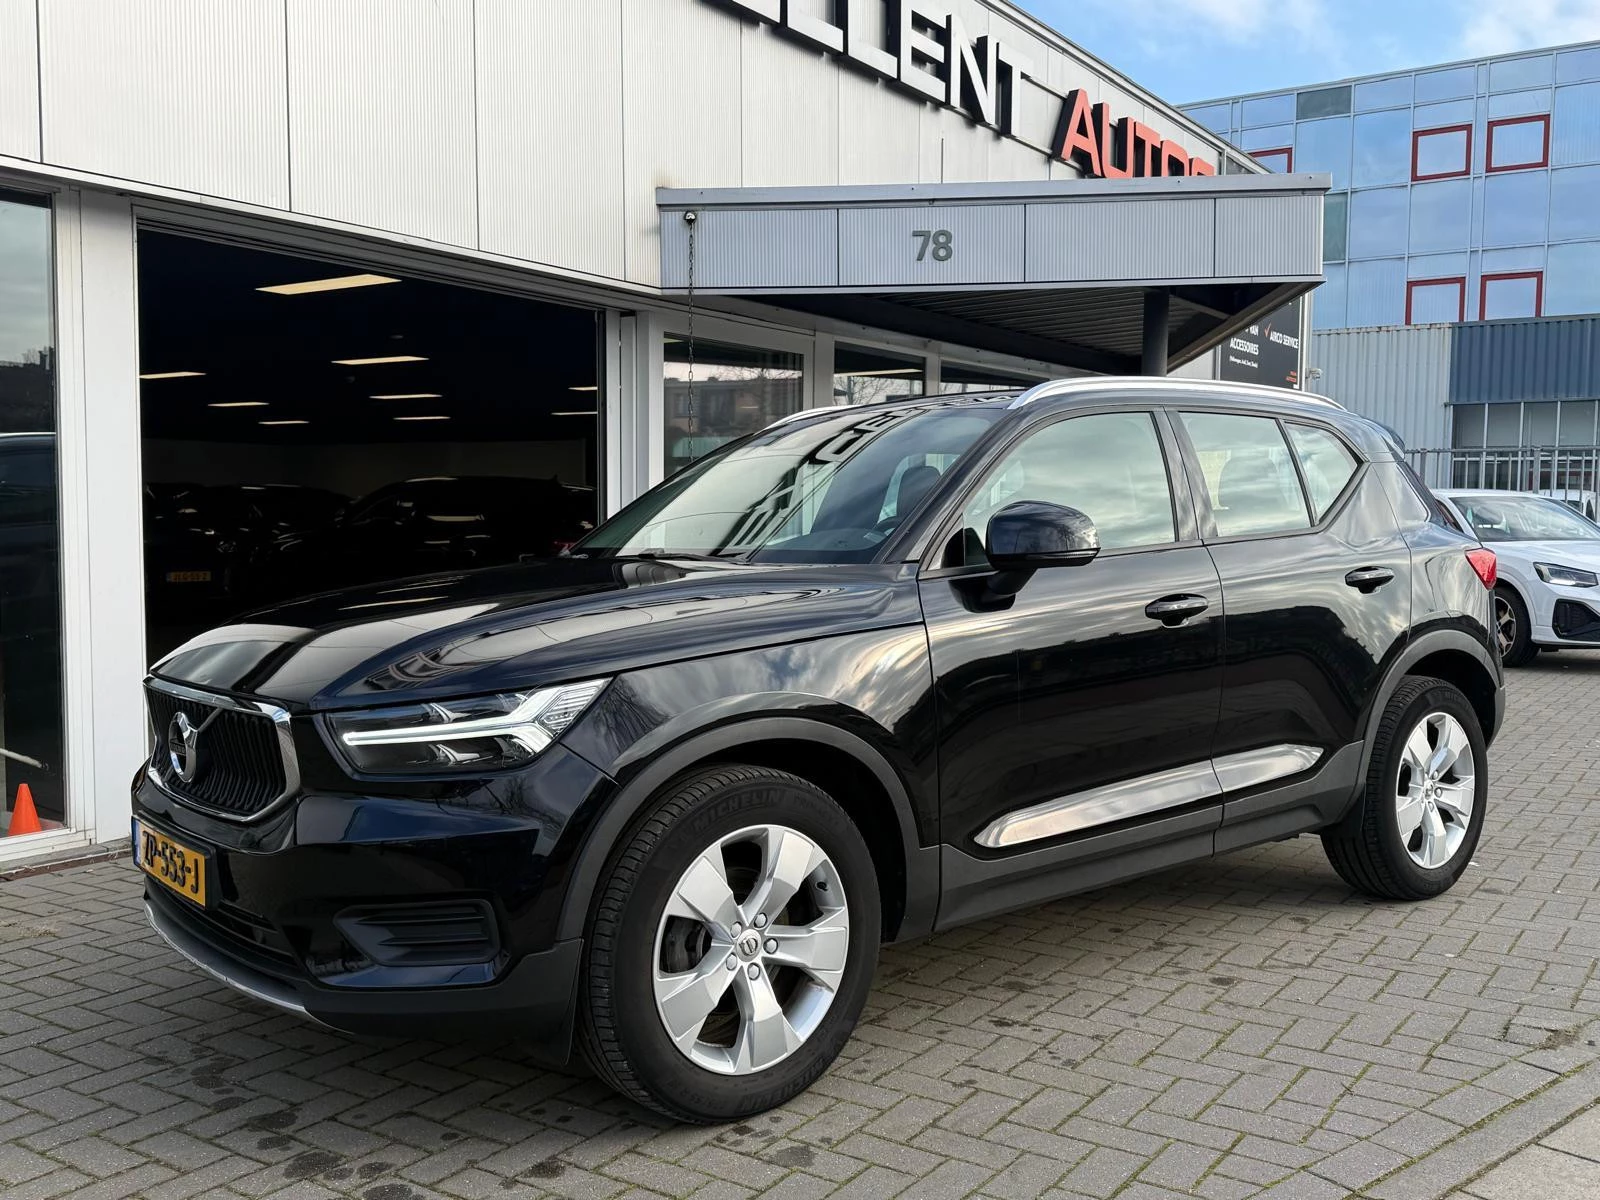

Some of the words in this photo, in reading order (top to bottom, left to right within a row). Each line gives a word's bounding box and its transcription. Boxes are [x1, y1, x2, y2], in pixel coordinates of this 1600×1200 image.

[733, 0, 1033, 138] LLENT
[912, 230, 953, 261] 78
[1229, 337, 1259, 355] ACCESSOIRES
[1269, 330, 1283, 344] AIRCO
[1282, 334, 1299, 349] SERVICE
